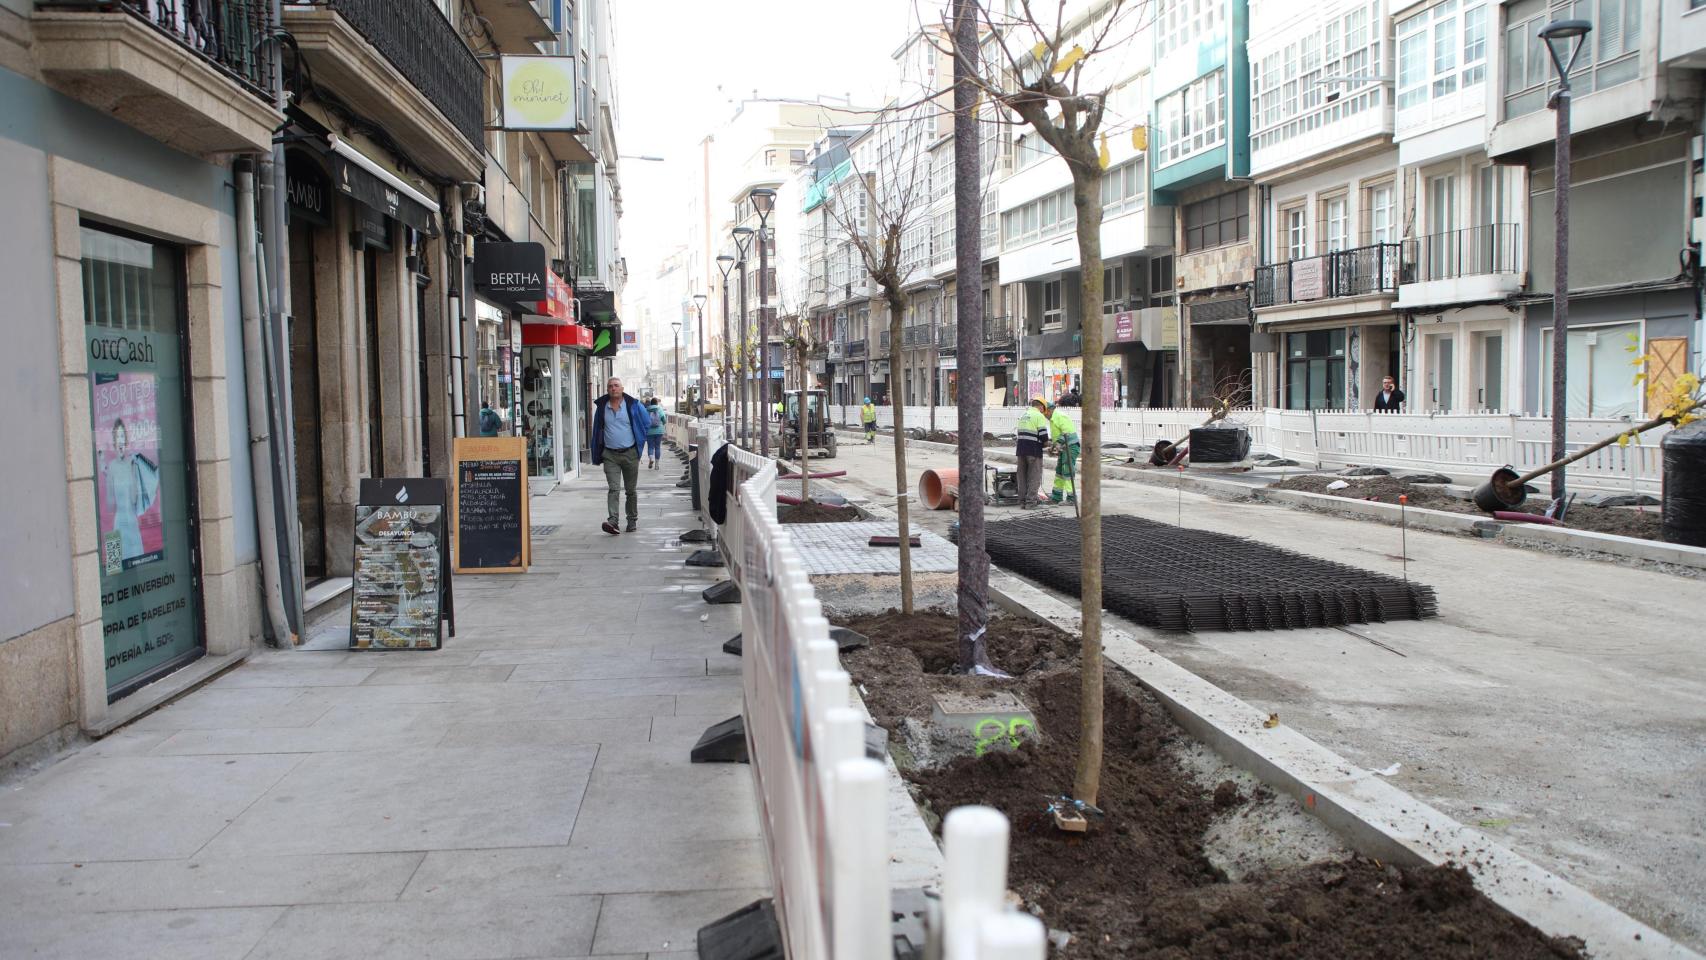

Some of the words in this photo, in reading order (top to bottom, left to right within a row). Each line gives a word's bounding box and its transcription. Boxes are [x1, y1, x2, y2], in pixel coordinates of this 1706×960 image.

[491, 272, 541, 285] BERTHA
[117, 587, 130, 602] DE
[131, 572, 176, 597] INVERSIÓN
[128, 614, 140, 629] DE
[141, 597, 186, 623] PAPELETAS
[144, 641, 156, 653] AL
